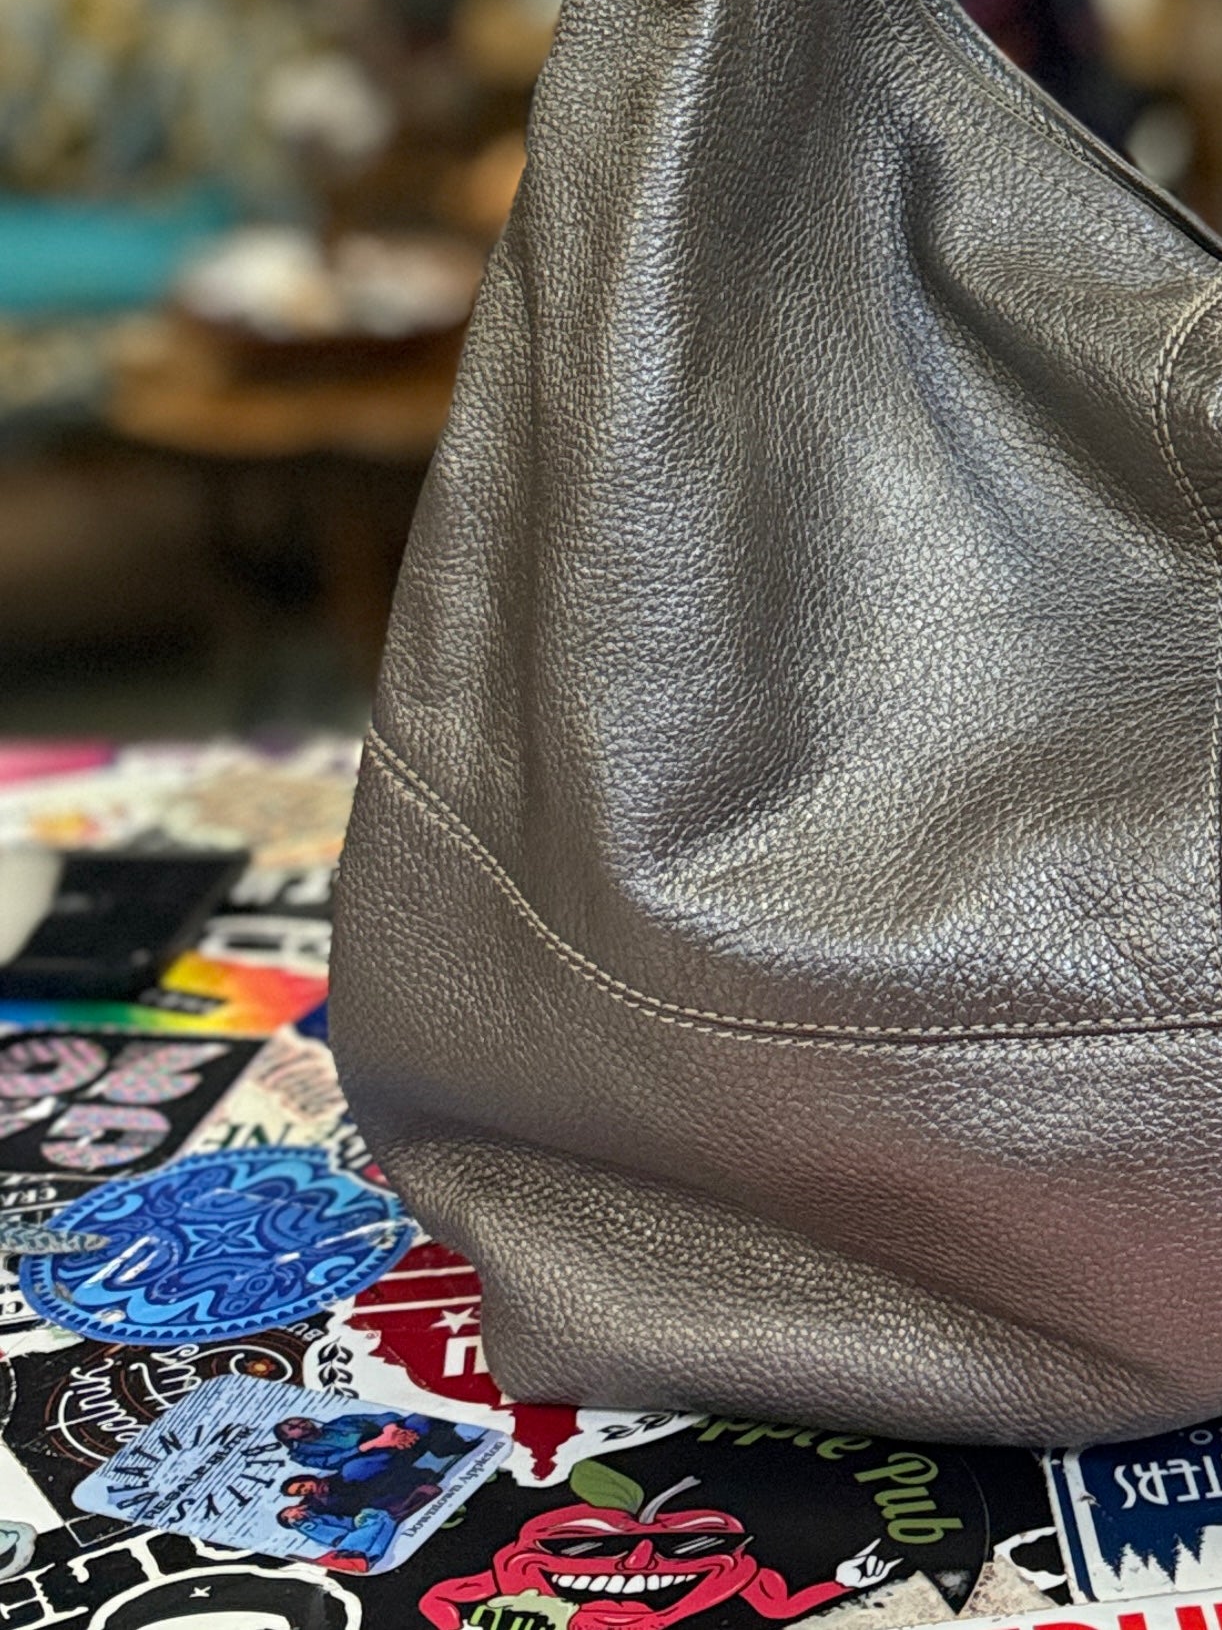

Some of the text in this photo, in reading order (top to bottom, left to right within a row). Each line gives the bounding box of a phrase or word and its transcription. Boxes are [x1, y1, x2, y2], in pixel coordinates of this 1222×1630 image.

[402, 1476, 463, 1539] Downtown
[459, 1440, 507, 1483] Appleton
[854, 1451, 966, 1546] Pub
